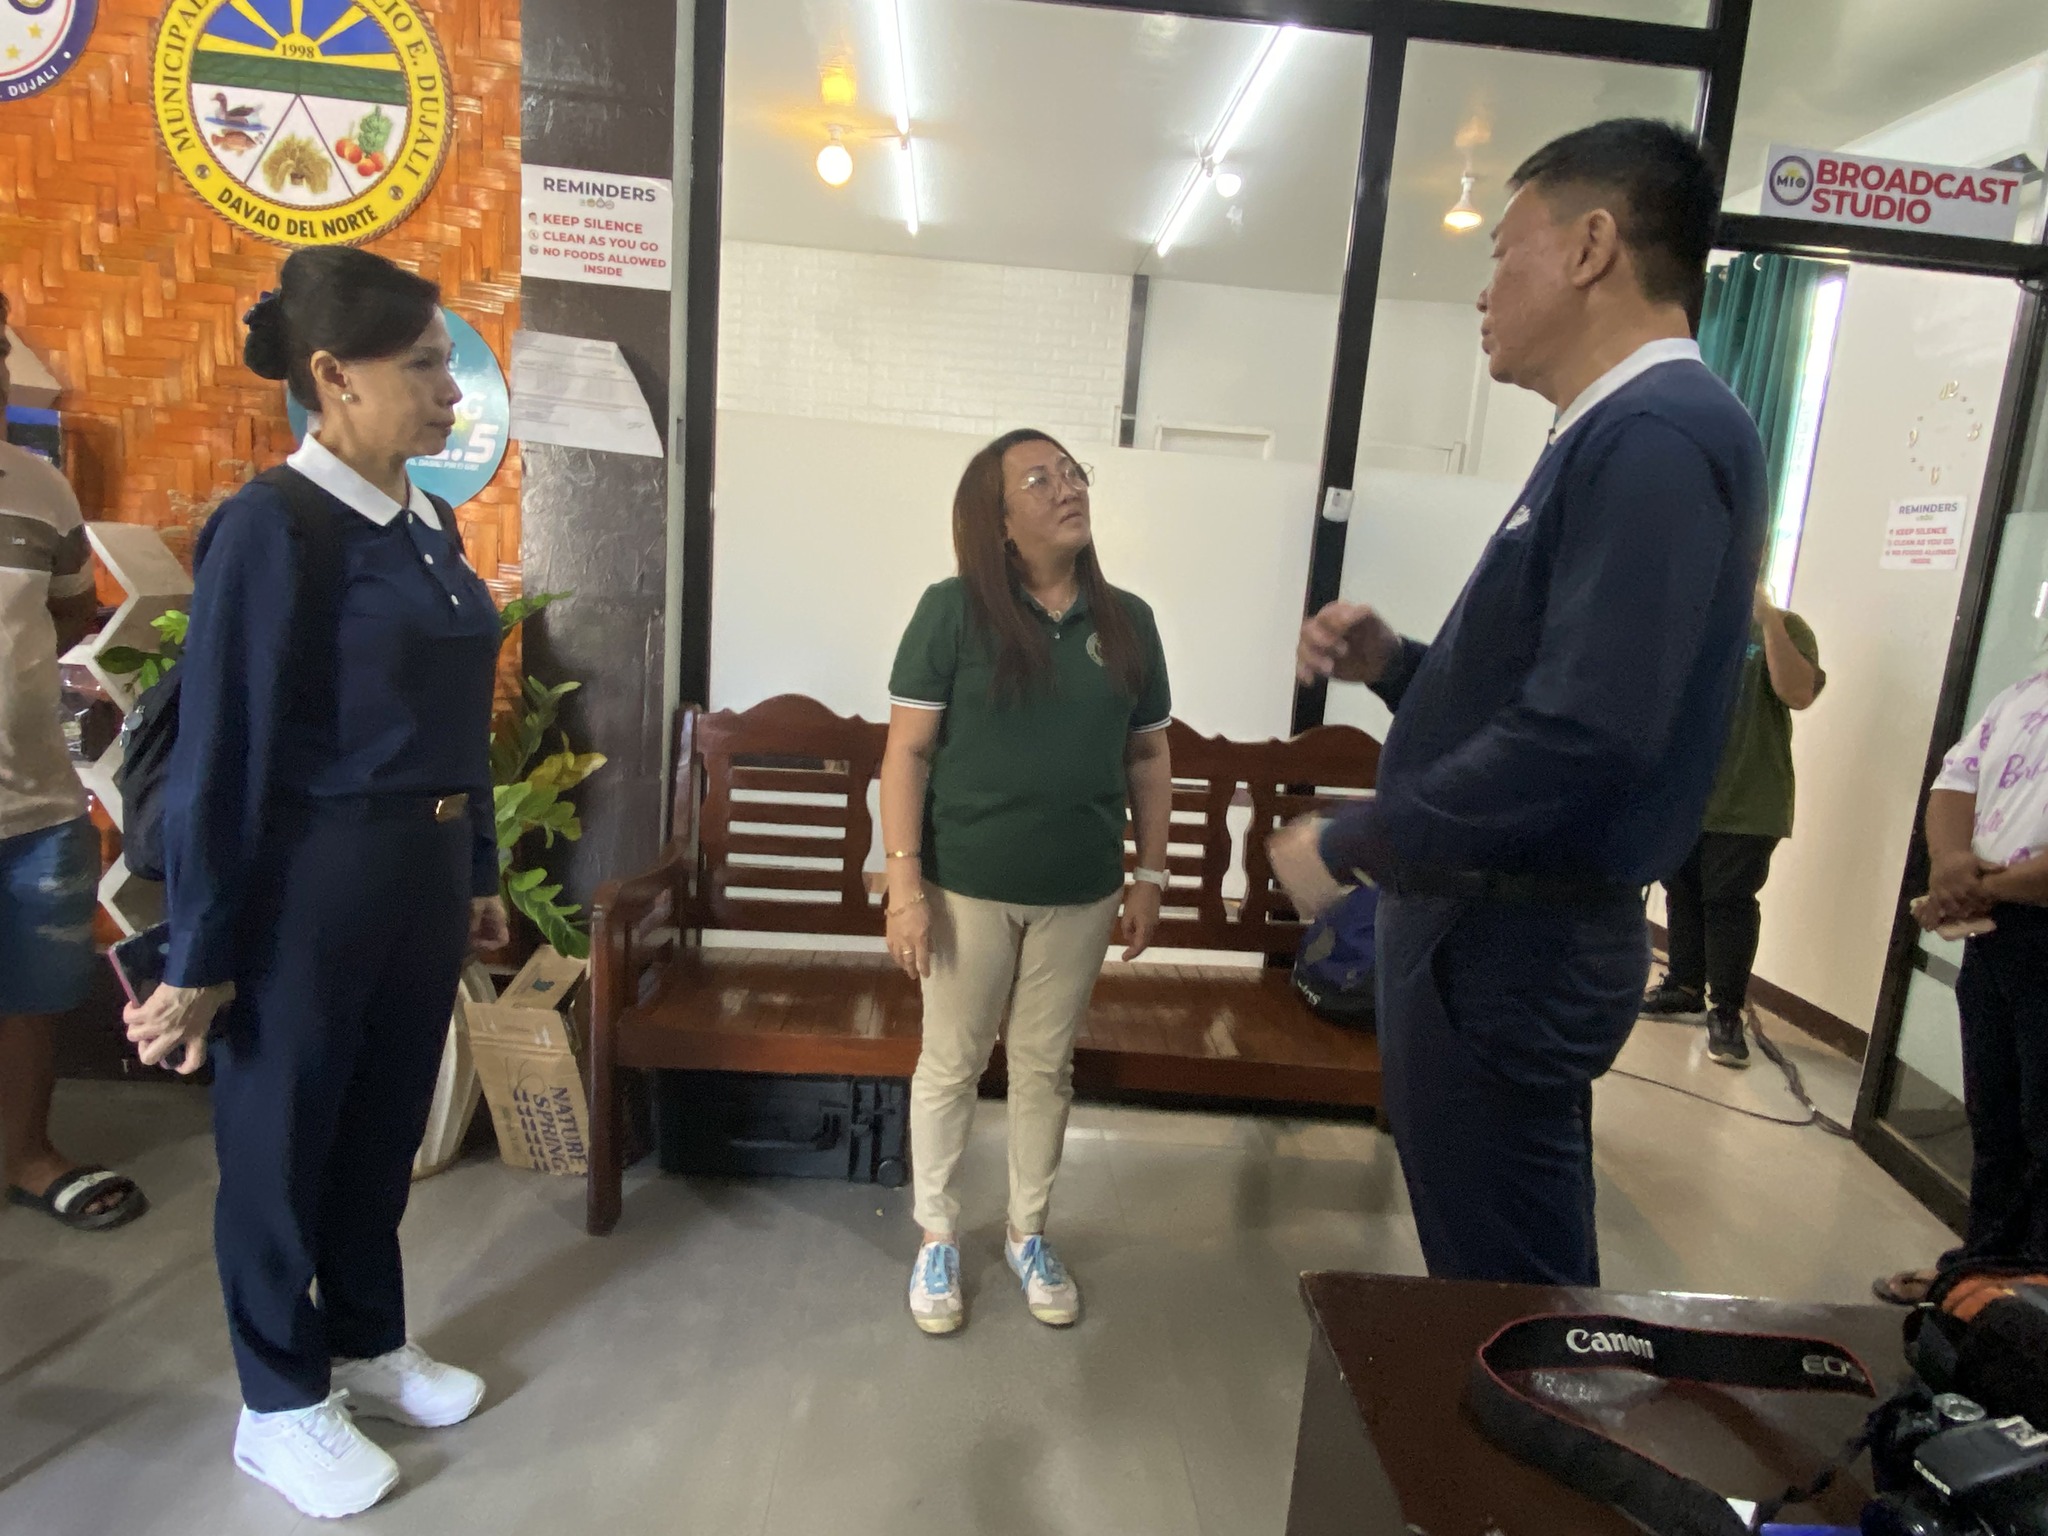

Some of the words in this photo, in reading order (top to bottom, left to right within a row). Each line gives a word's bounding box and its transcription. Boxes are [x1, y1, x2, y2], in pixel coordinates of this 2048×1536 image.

[281, 44, 315, 59] 1998
[406, 40, 428, 67] E.
[8, 65, 58, 97] DUJALI
[403, 74, 440, 180] DUJALI
[543, 177, 656, 202] REMINDERS
[1816, 159, 2019, 206] BROADCAST
[217, 188, 280, 231] DAVAO
[286, 218, 317, 239] DEL
[322, 204, 378, 237] NORTE
[1811, 188, 1932, 224] STUDIO
[543, 213, 580, 227] KEEP
[584, 218, 643, 234] SILENCE
[543, 231, 585, 245] CLEAN
[589, 236, 606, 246] AS
[609, 238, 637, 249] YOU
[640, 242, 659, 252] GO
[543, 247, 561, 257] NO
[564, 250, 605, 262] FOODS
[608, 254, 667, 268] ALLOWED
[584, 264, 623, 277] INSIDE
[1899, 503, 1958, 514] REMINDERS
[533, 1094, 568, 1170] SPRING
[1565, 1328, 1655, 1360] Canon
